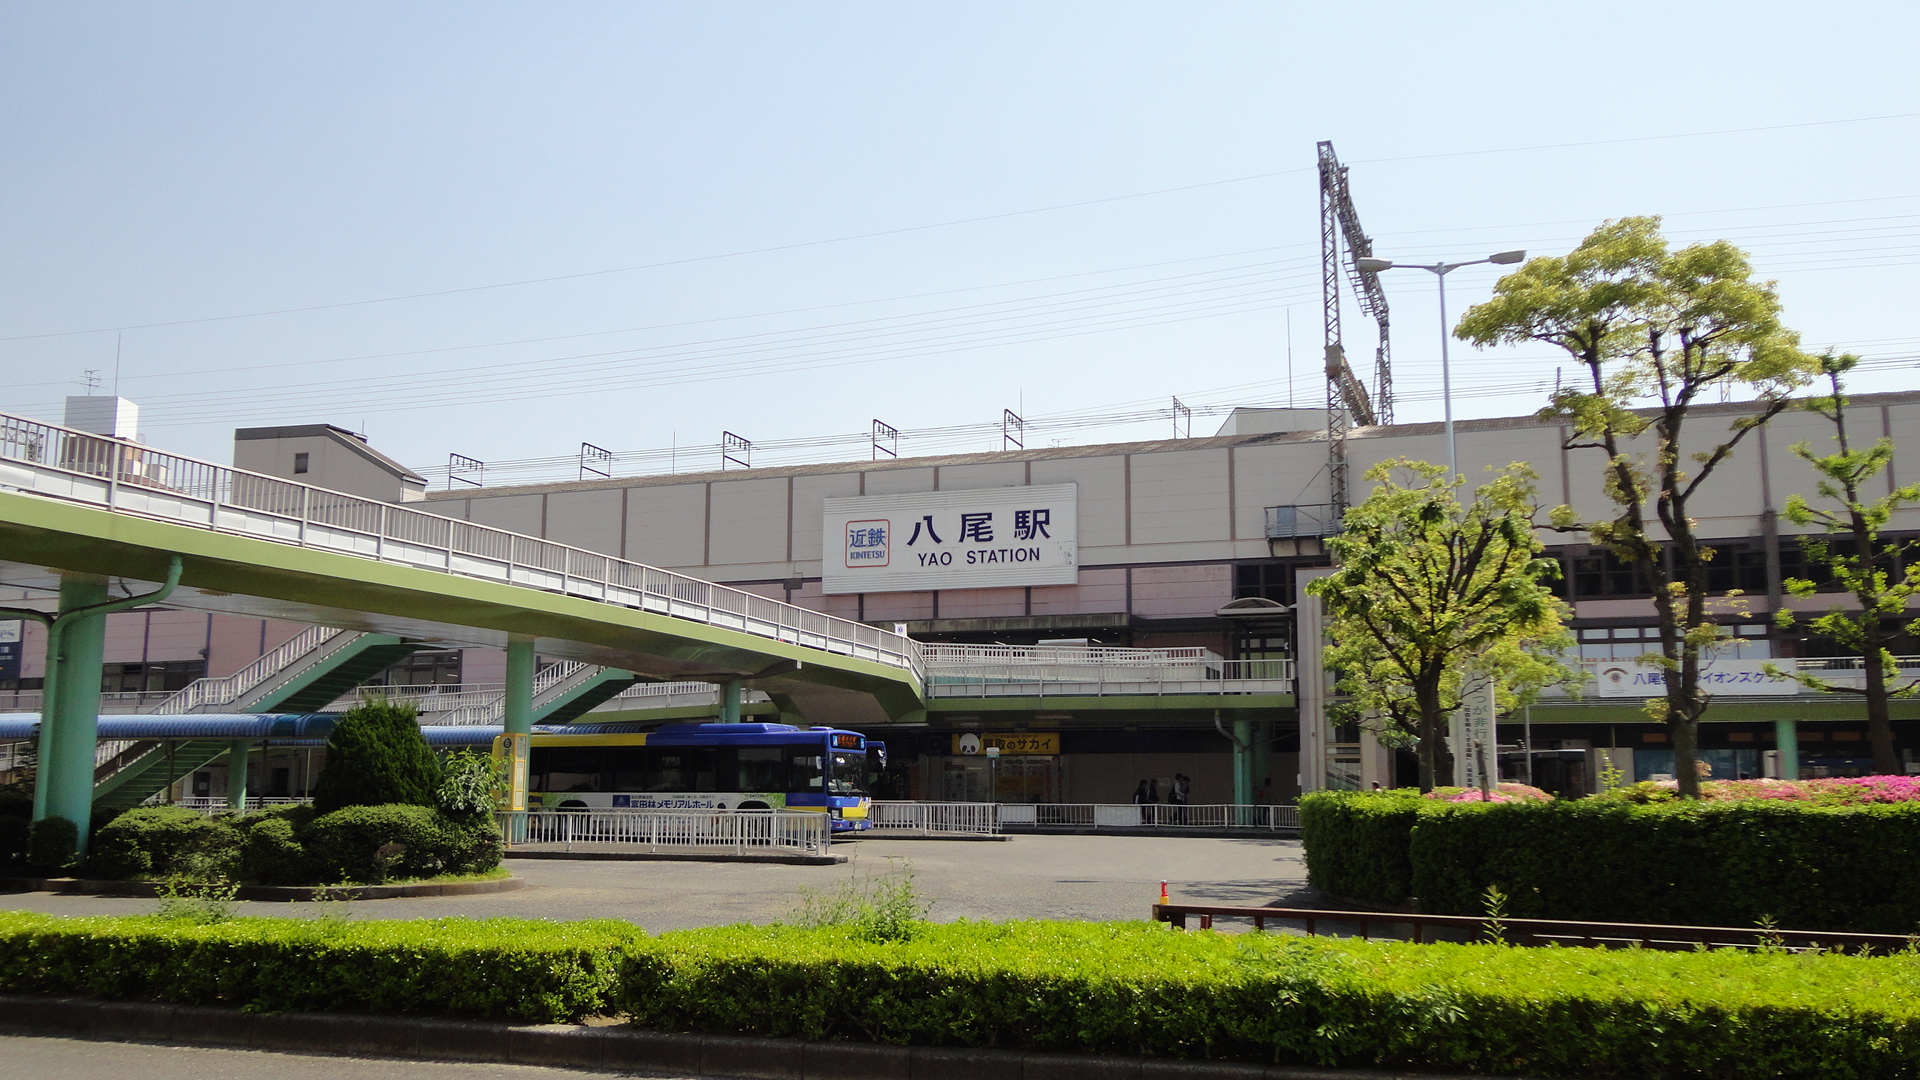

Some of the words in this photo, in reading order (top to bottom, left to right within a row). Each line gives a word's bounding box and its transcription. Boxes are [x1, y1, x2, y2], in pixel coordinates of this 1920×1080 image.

[849, 527, 886, 548] 近鉄
[907, 509, 1051, 546] 八尾駅
[850, 550, 885, 560] KINTETSU
[917, 552, 953, 567] YAO
[966, 547, 1040, 564] STATION
[630, 799, 714, 809] 富田林メモリアルホール
